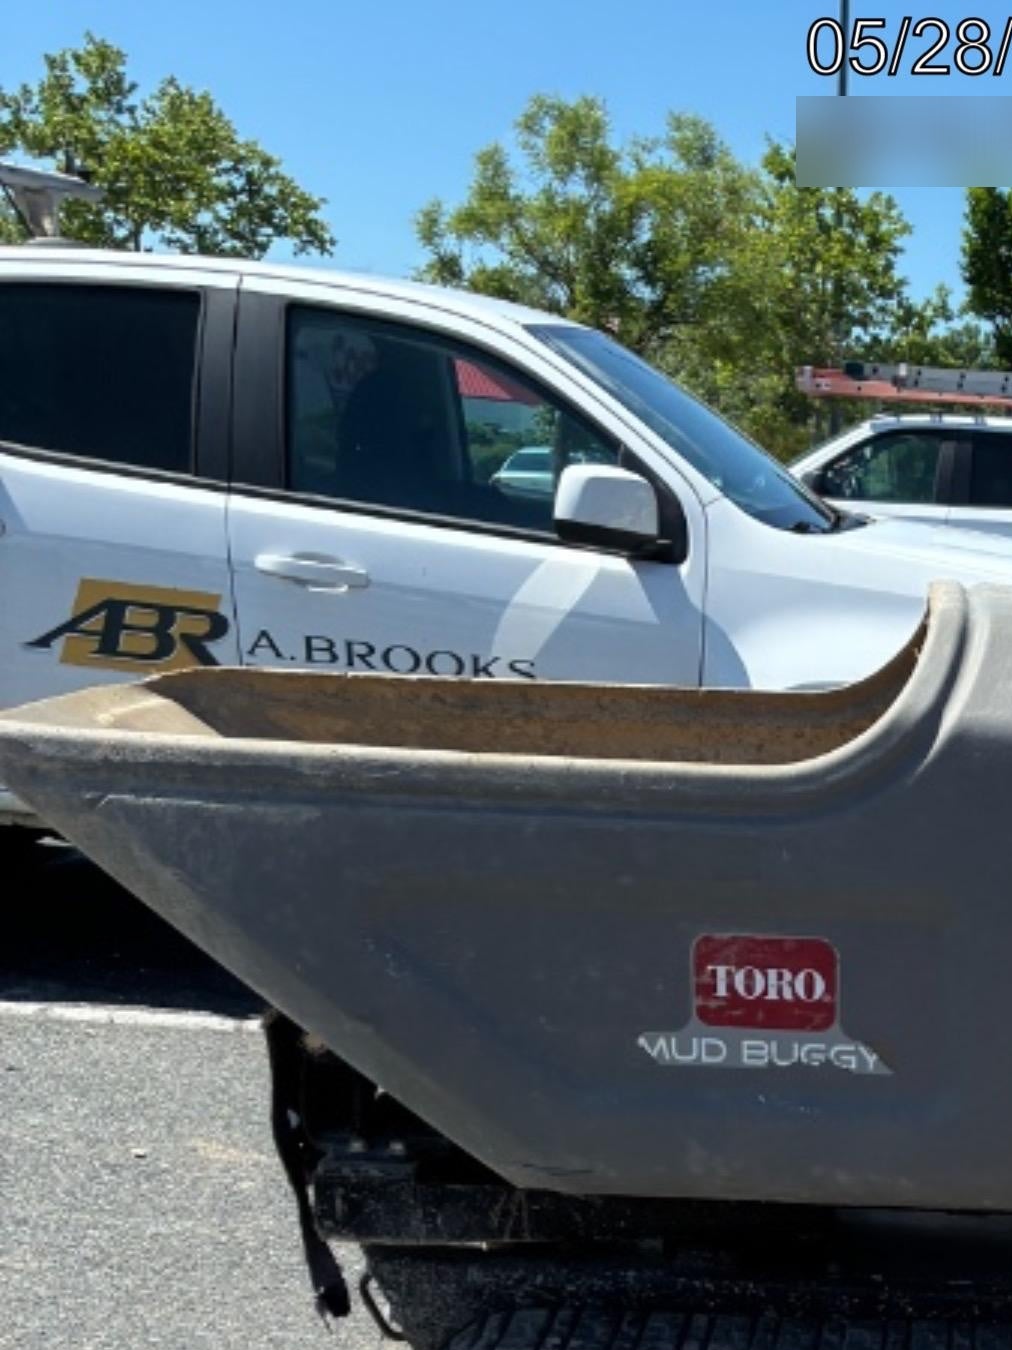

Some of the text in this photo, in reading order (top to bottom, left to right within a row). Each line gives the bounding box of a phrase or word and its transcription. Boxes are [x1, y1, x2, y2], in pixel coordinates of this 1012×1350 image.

[25, 596, 230, 666] ABR
[706, 964, 829, 1002] TORO
[637, 1036, 879, 1071] MUD BUGGY
